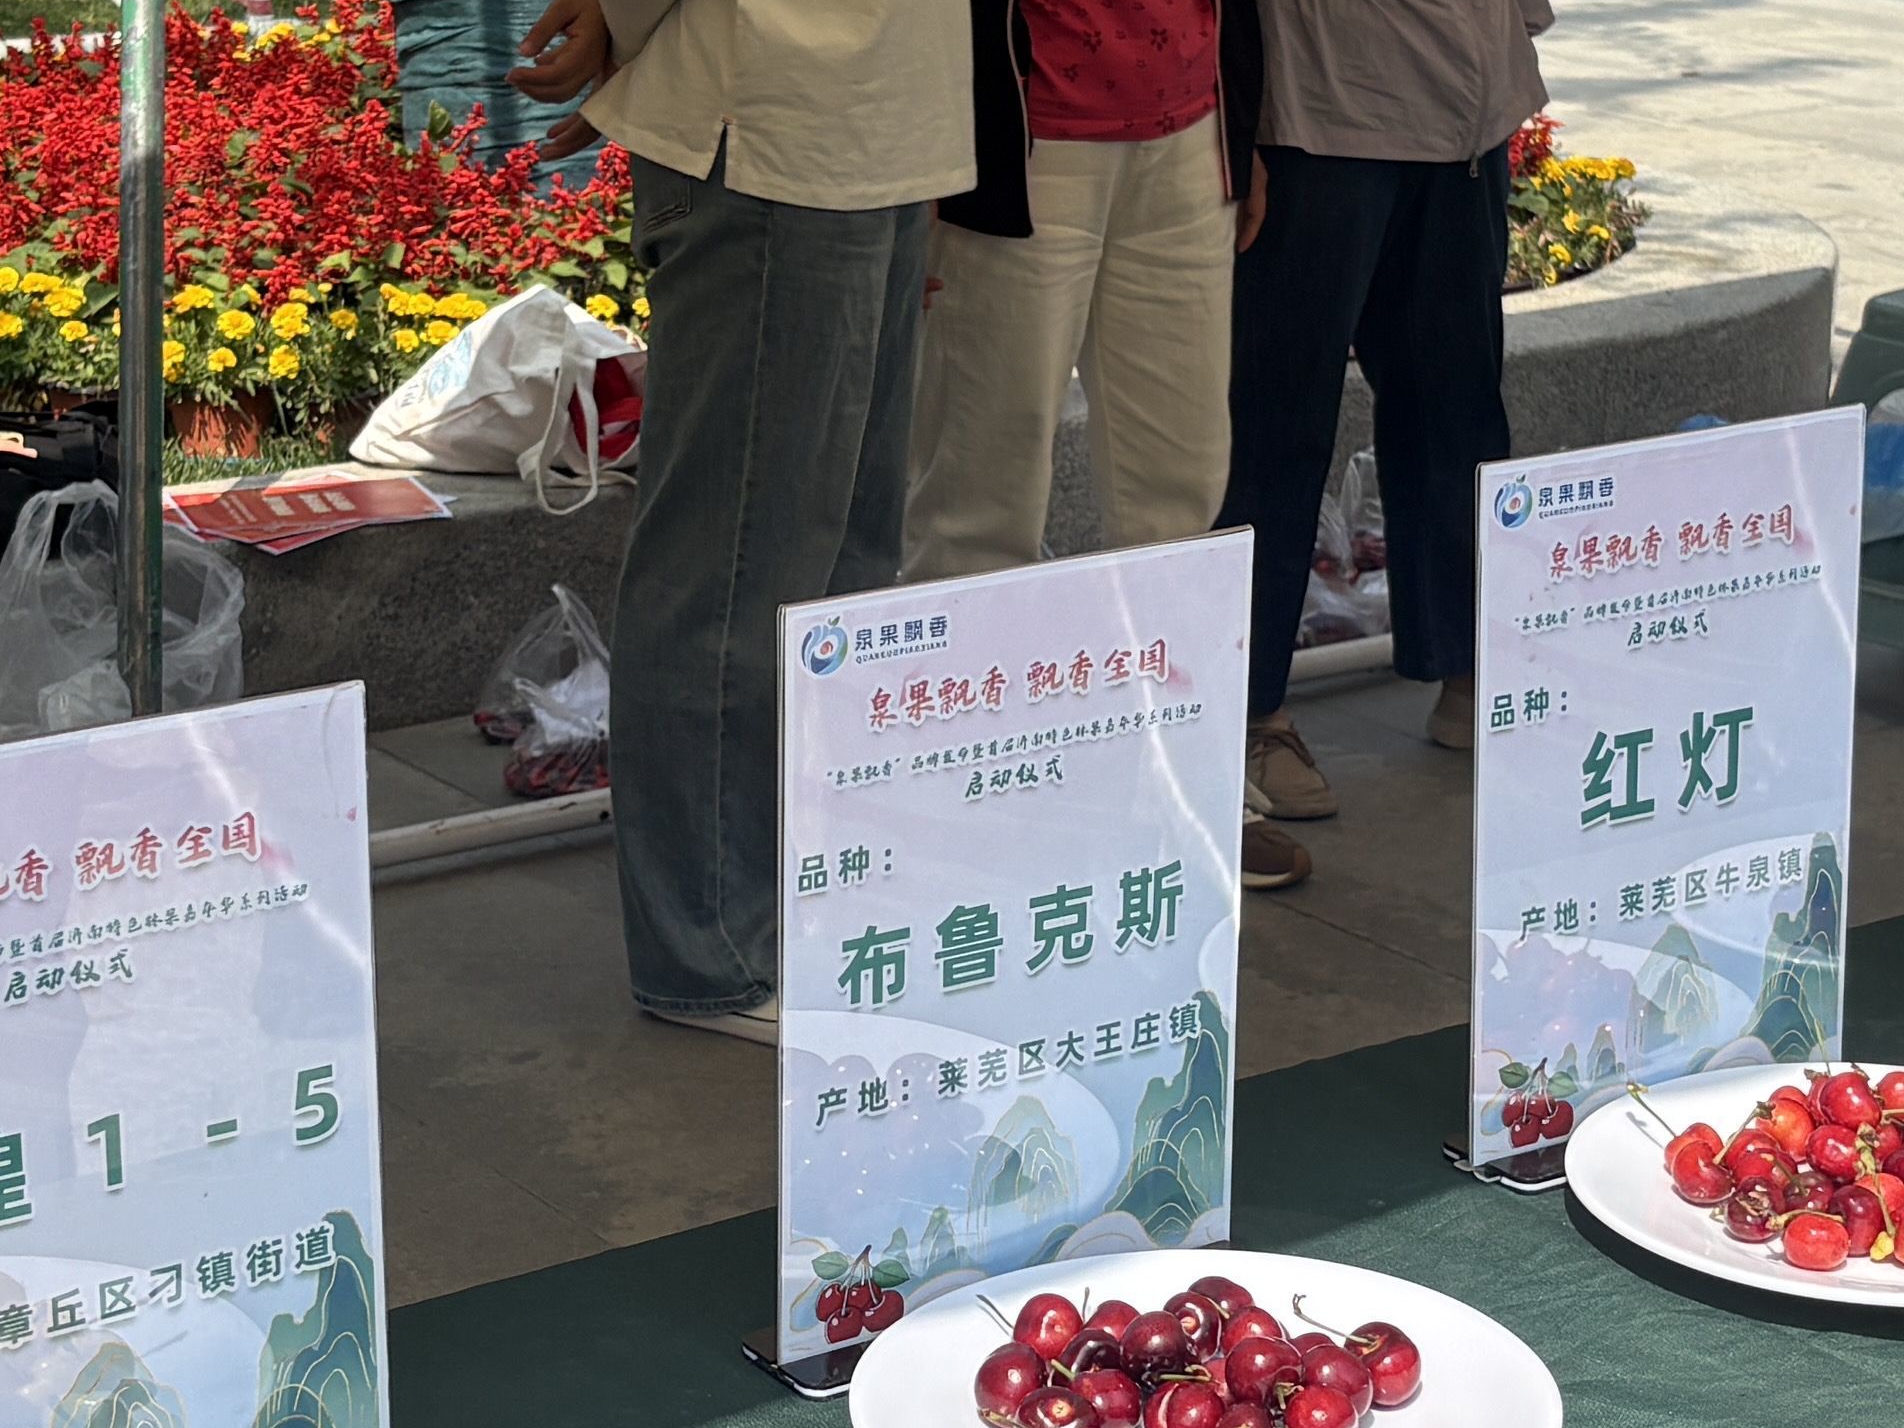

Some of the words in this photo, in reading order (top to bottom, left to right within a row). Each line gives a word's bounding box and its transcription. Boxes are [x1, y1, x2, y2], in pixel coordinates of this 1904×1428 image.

[1539, 477, 1614, 507] 泉果飘香
[1550, 525, 1662, 577] 泉果飘香
[1678, 503, 1793, 555] 飘香全国
[855, 616, 948, 651] 泉果飘香
[1628, 608, 1709, 646] 启动仪式
[869, 665, 1007, 728] 泉果飘香
[1026, 638, 1166, 698] 飘香全国
[1489, 687, 1572, 731] 品种：
[965, 755, 1063, 798] 启动仪式
[1580, 707, 1754, 827] 红灯
[75, 811, 256, 885] 飘香全国
[796, 846, 896, 894] 品种：
[1520, 845, 1803, 942] 产地：莱芜区牛泉镇
[837, 859, 1186, 1008] 布鲁克斯
[4, 949, 133, 1002] 启动仪式
[814, 1002, 1201, 1129] 产地：莱芜区大王庄镇
